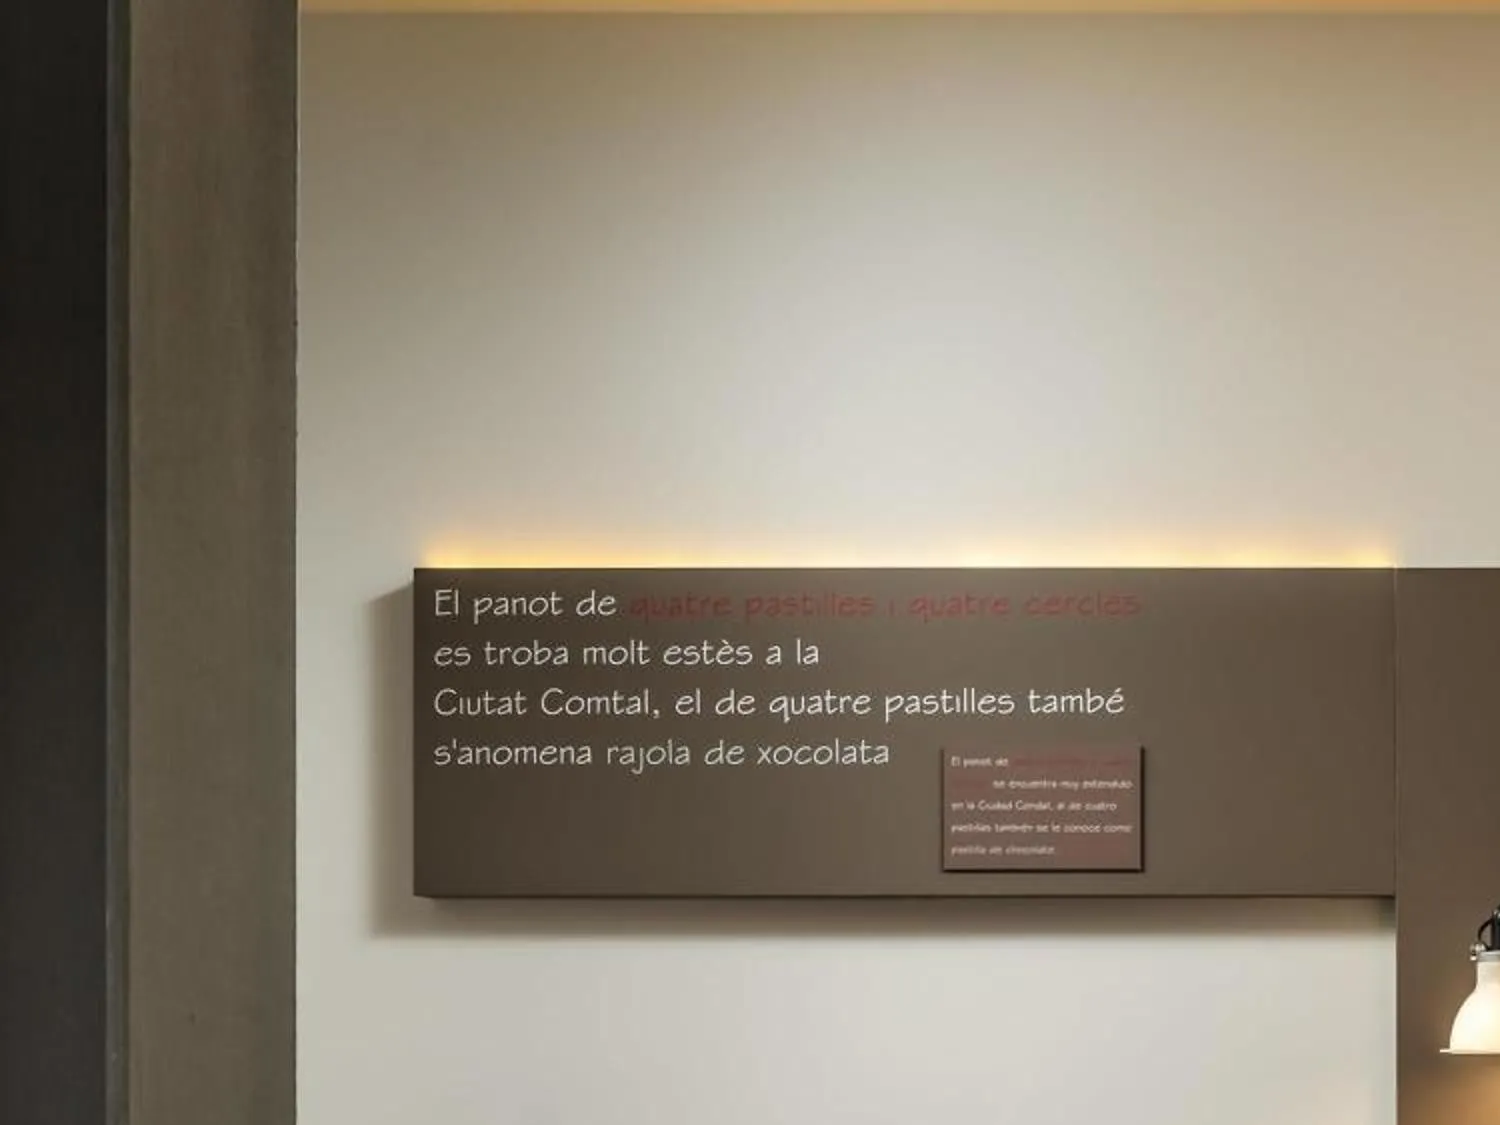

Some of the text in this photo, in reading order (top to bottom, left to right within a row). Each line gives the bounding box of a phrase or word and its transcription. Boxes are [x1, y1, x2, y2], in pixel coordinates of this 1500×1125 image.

[435, 589, 459, 616] El
[474, 592, 563, 624] panot
[576, 590, 616, 616] de
[630, 589, 729, 623] quatre
[745, 590, 875, 623] pastilles
[909, 589, 1010, 623] quatre
[1025, 590, 1144, 619] cercles
[434, 638, 819, 666] es troba molt estès a la
[434, 688, 1124, 723] Ciutat Comtal, el de quatre pastilles també
[434, 738, 889, 774] s'anomena rajola de xocolata
[951, 756, 960, 767] El
